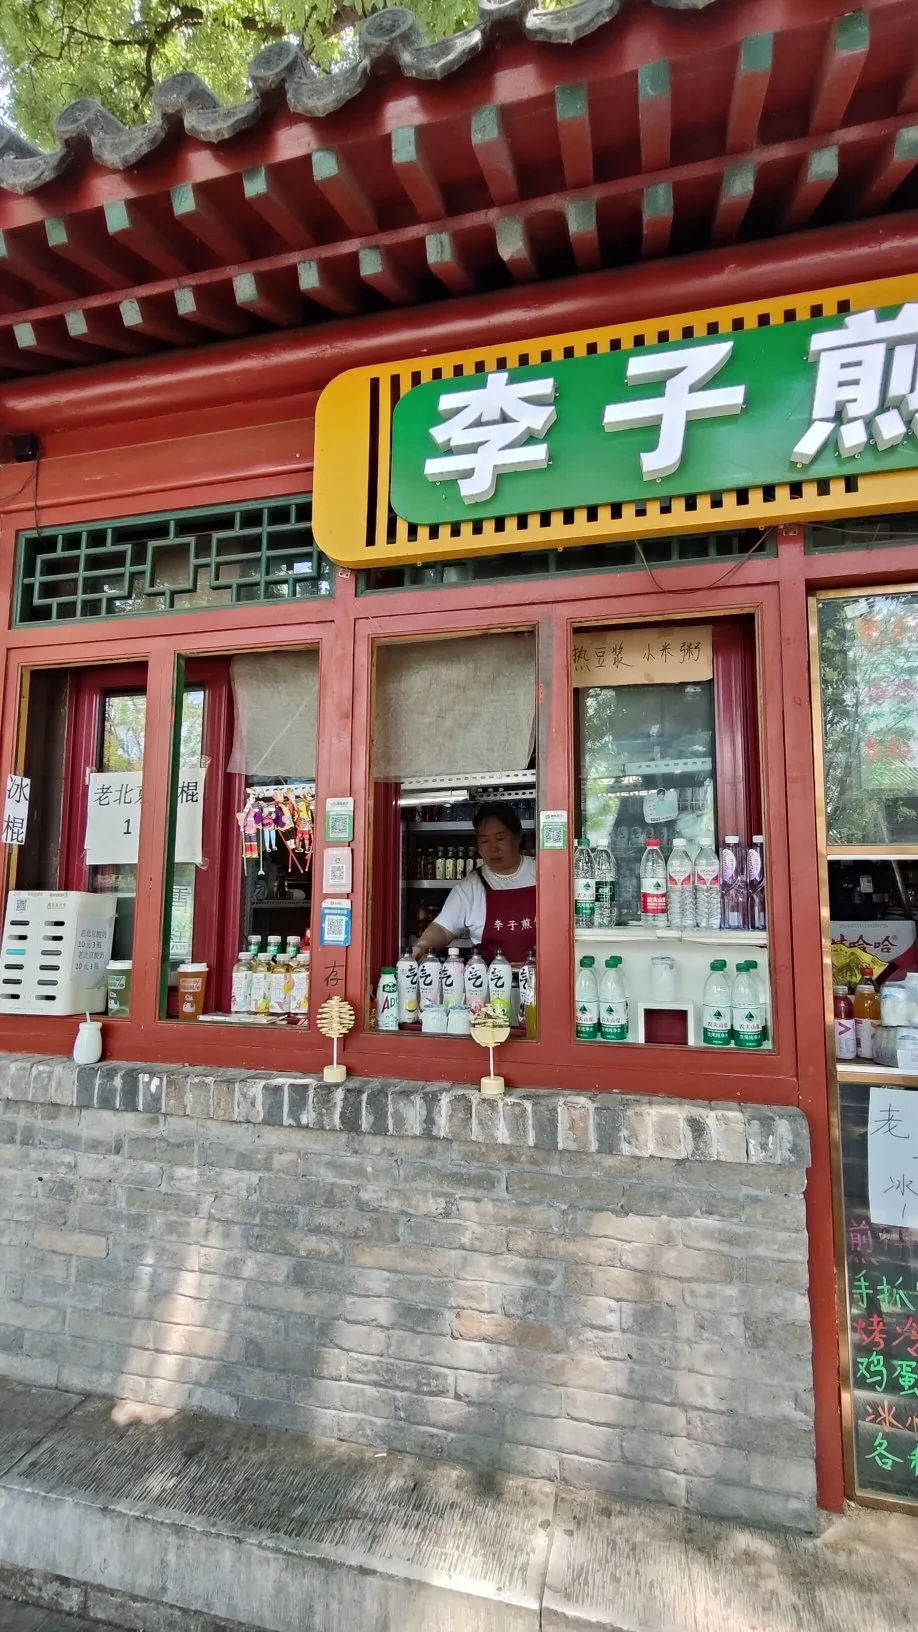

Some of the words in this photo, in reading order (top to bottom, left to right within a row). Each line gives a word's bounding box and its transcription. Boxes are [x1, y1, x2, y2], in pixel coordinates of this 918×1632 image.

[573, 640, 634, 672] 热豆浆
[643, 641, 702, 664] 小米粥
[3, 775, 29, 844] 冰棍
[493, 918, 537, 931] 李子煎
[870, 1103, 910, 1139] 老
[883, 1173, 918, 1197] 冰
[852, 1269, 918, 1313] 手抓
